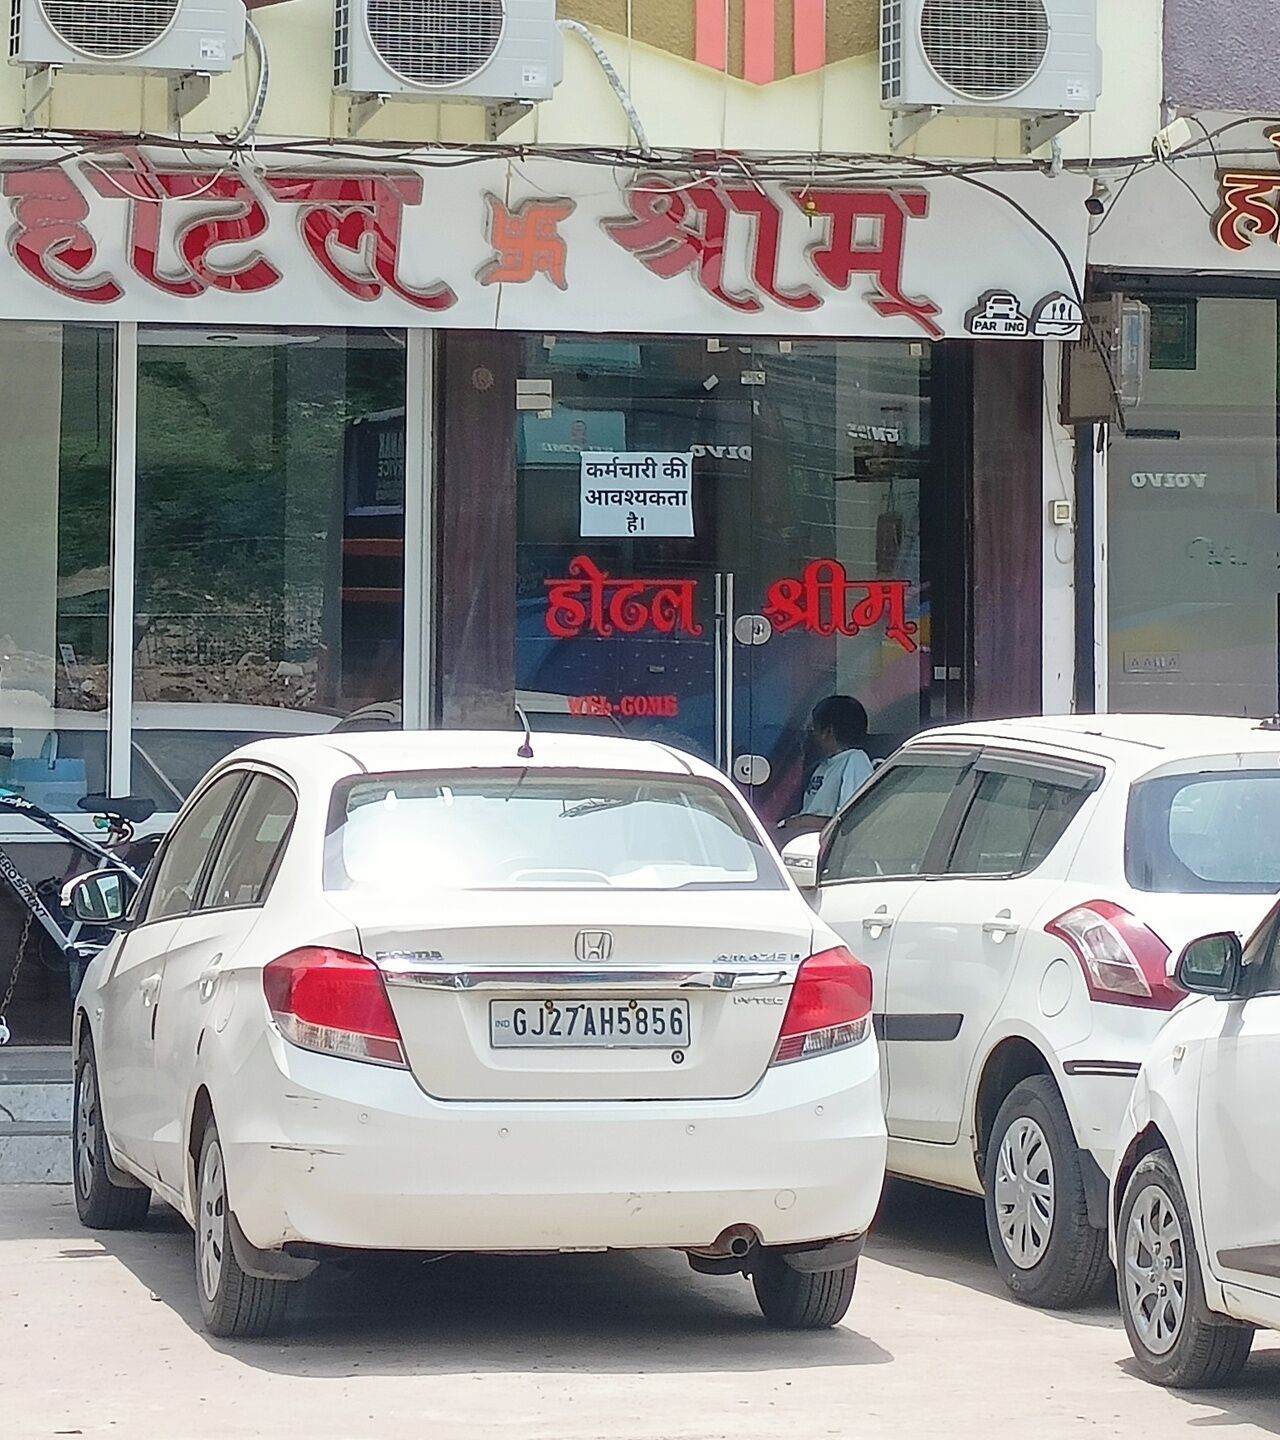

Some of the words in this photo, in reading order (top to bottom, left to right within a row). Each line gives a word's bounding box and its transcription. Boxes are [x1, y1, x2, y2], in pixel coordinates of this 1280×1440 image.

[585, 457, 659, 481] कर्मचारी
[662, 456, 688, 480] की
[584, 487, 688, 507] आवश्यकता
[625, 511, 645, 534] है।
[544, 555, 703, 639] होटल
[513, 1006, 684, 1037] GJ27AH5856
